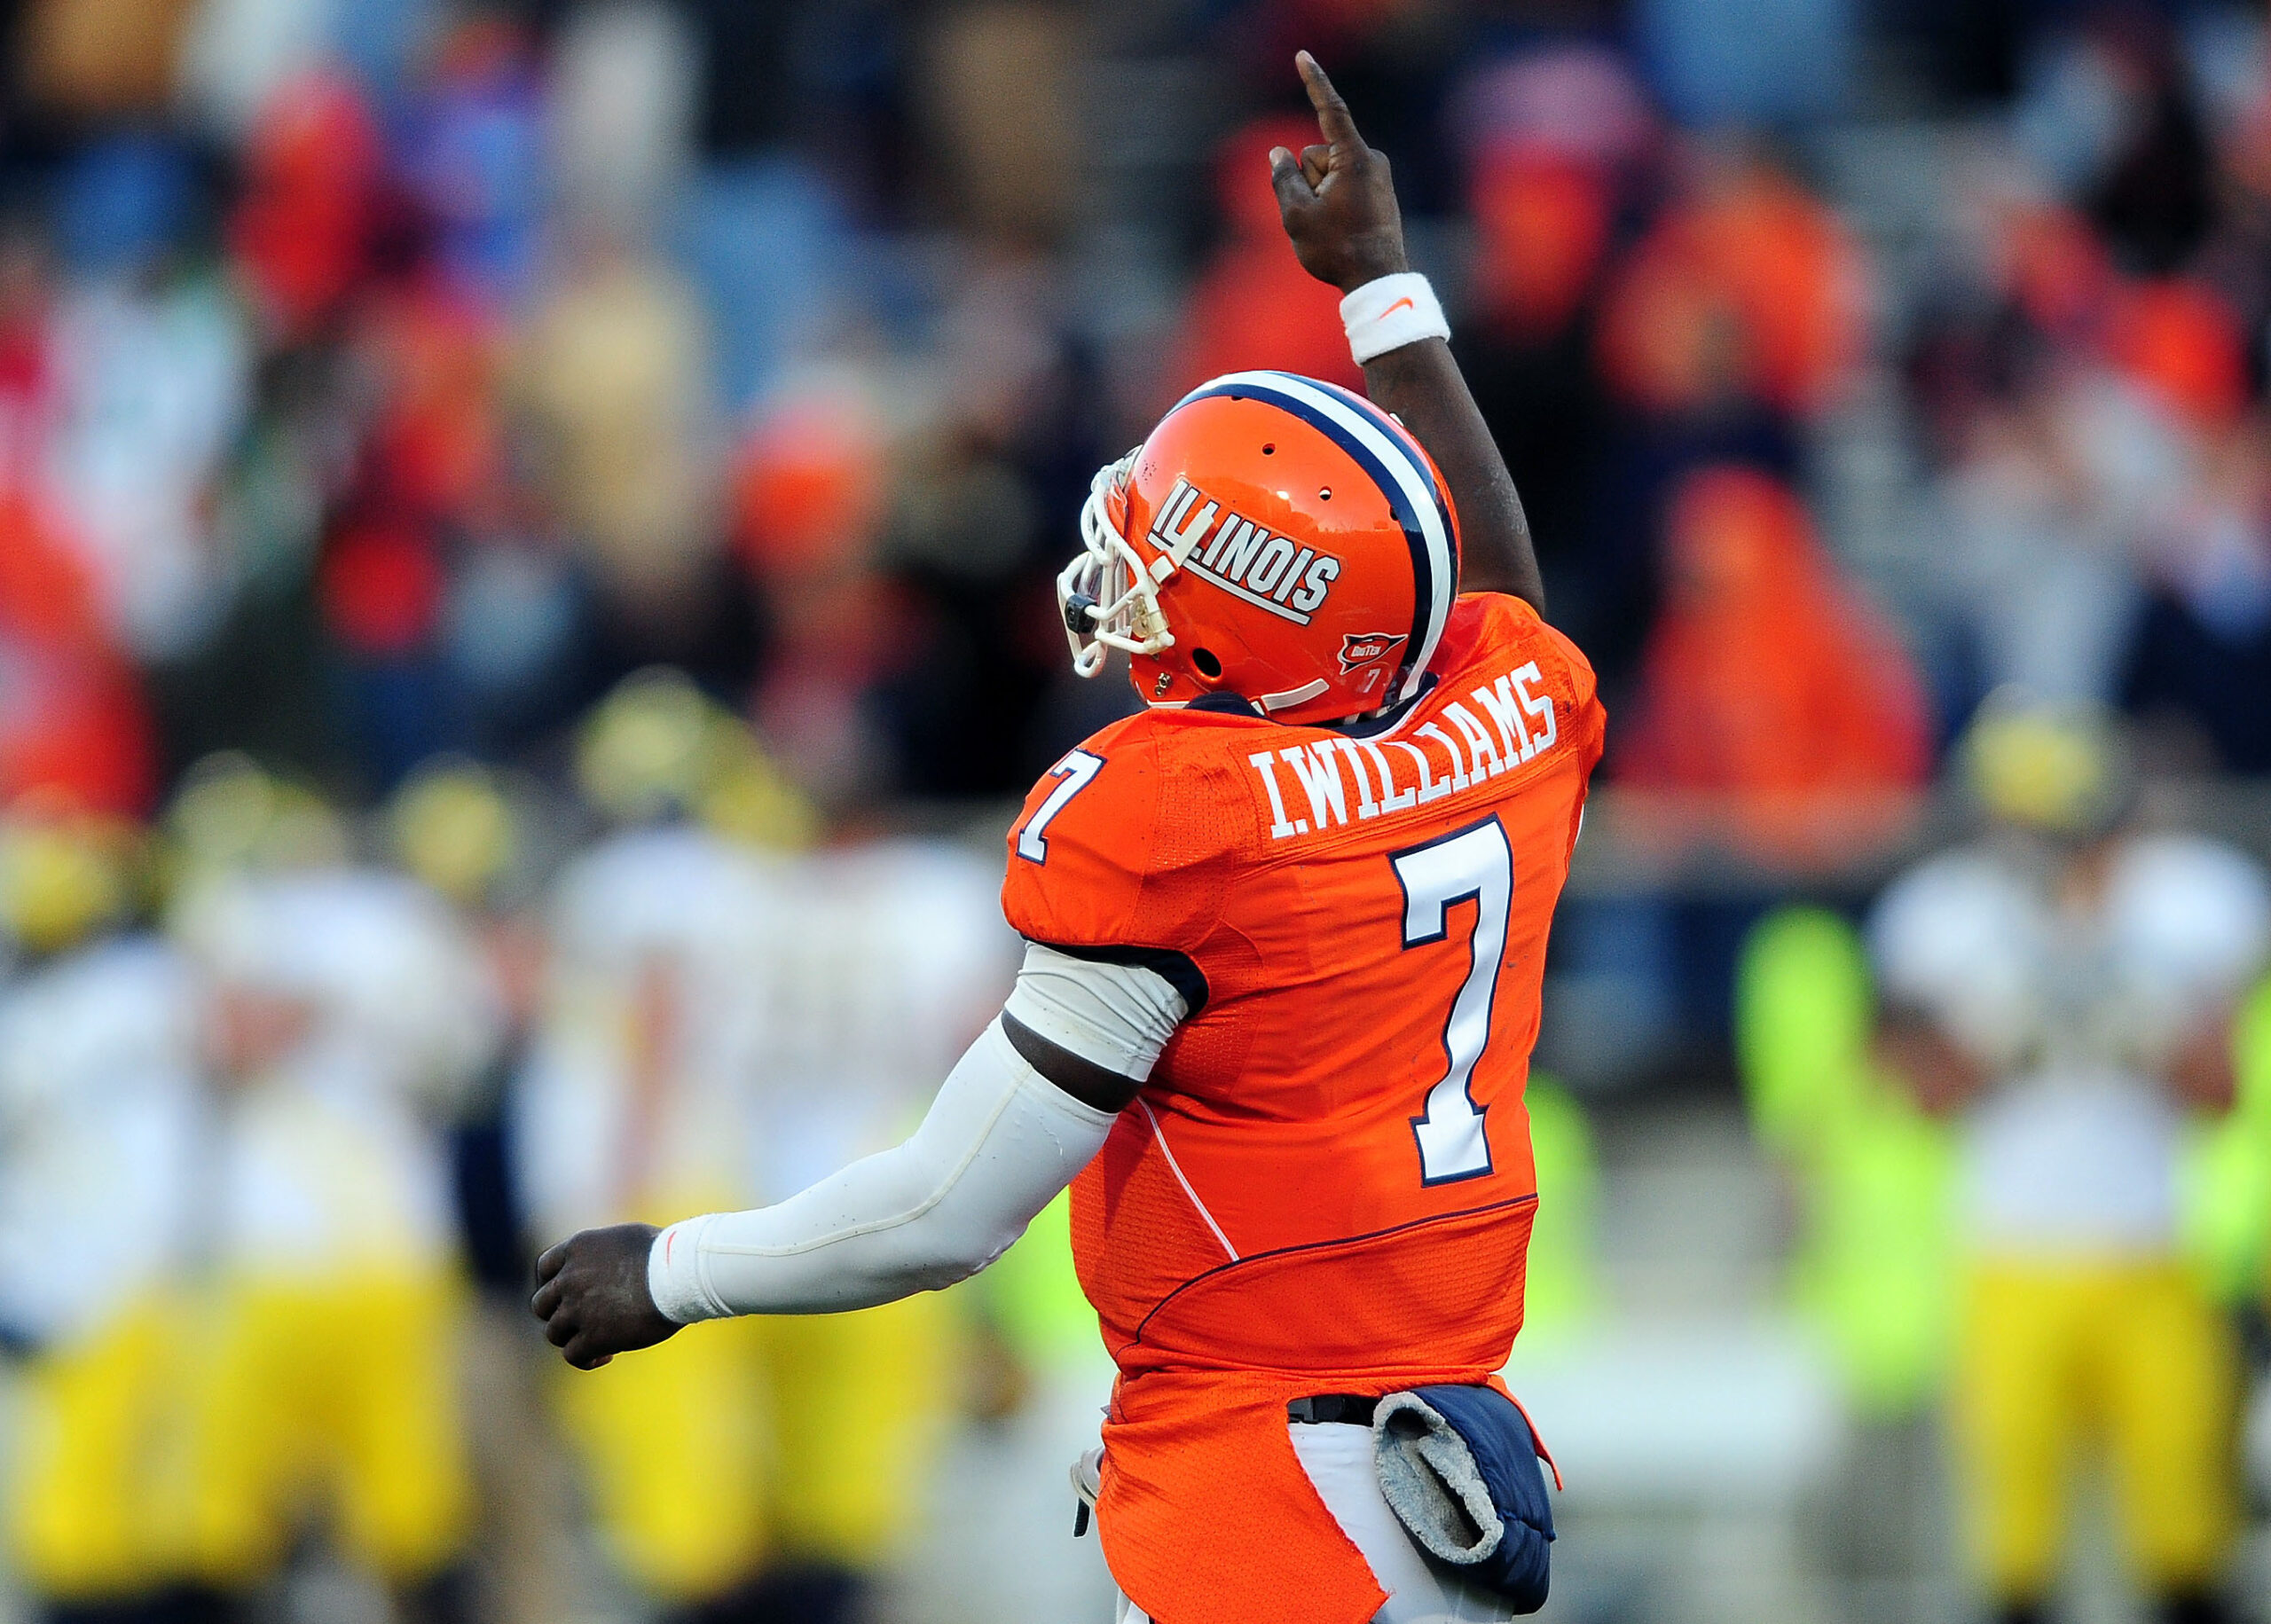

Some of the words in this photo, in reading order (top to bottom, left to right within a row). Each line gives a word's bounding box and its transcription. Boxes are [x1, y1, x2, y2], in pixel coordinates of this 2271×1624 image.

[1248, 660, 1557, 839] I.WILLIAMS
[1363, 668, 1381, 693] 7
[1016, 748, 1108, 867] 7
[1387, 812, 1513, 1188] 7
